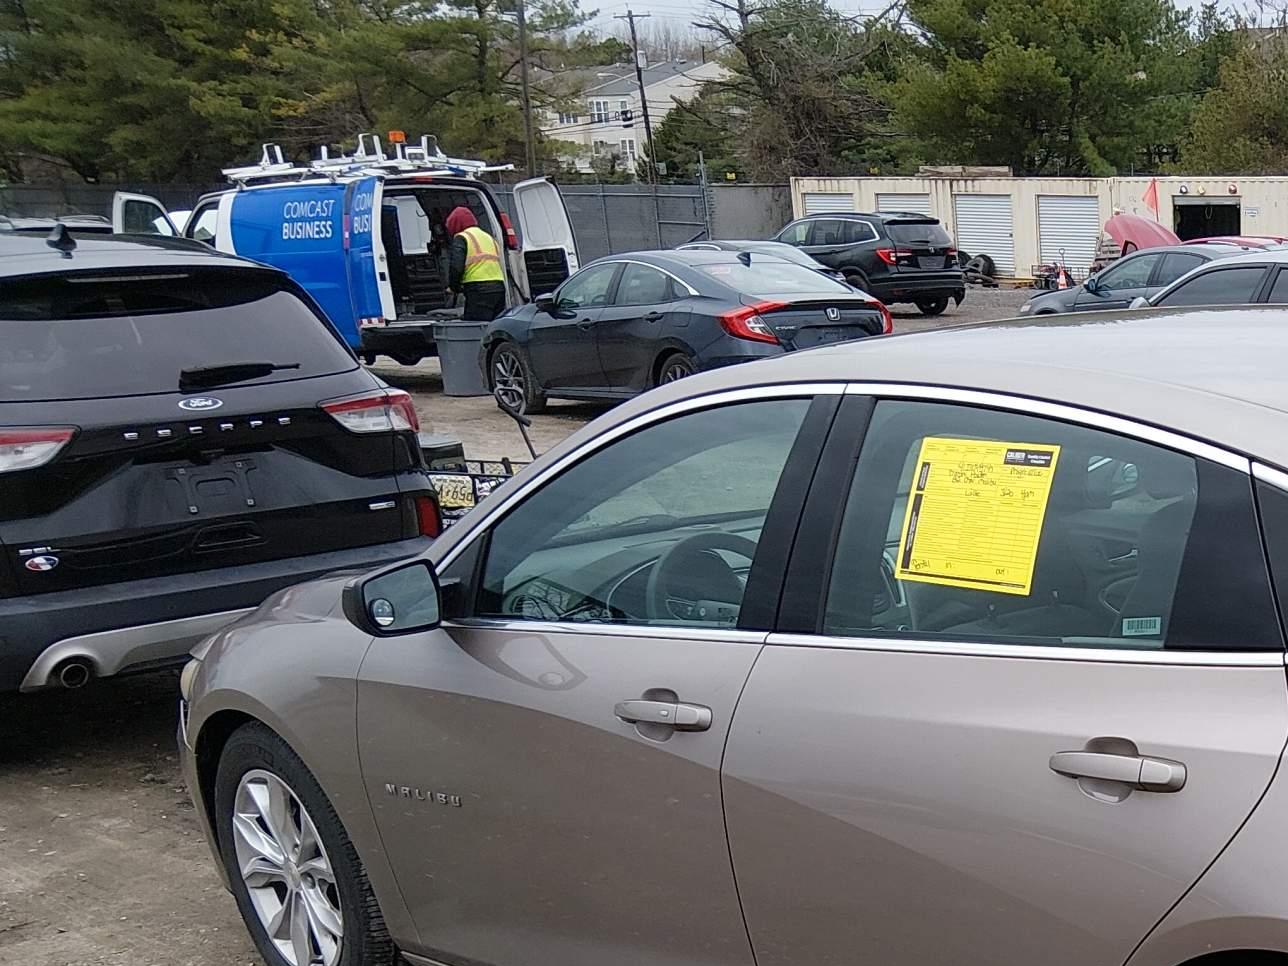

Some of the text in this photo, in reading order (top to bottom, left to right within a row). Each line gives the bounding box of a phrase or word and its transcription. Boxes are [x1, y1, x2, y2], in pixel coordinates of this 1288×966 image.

[283, 199, 336, 219] COMCAST
[282, 220, 333, 240] BUSINESS
[124, 417, 291, 440] ESCAPE
[385, 783, 462, 807] MALIBU
